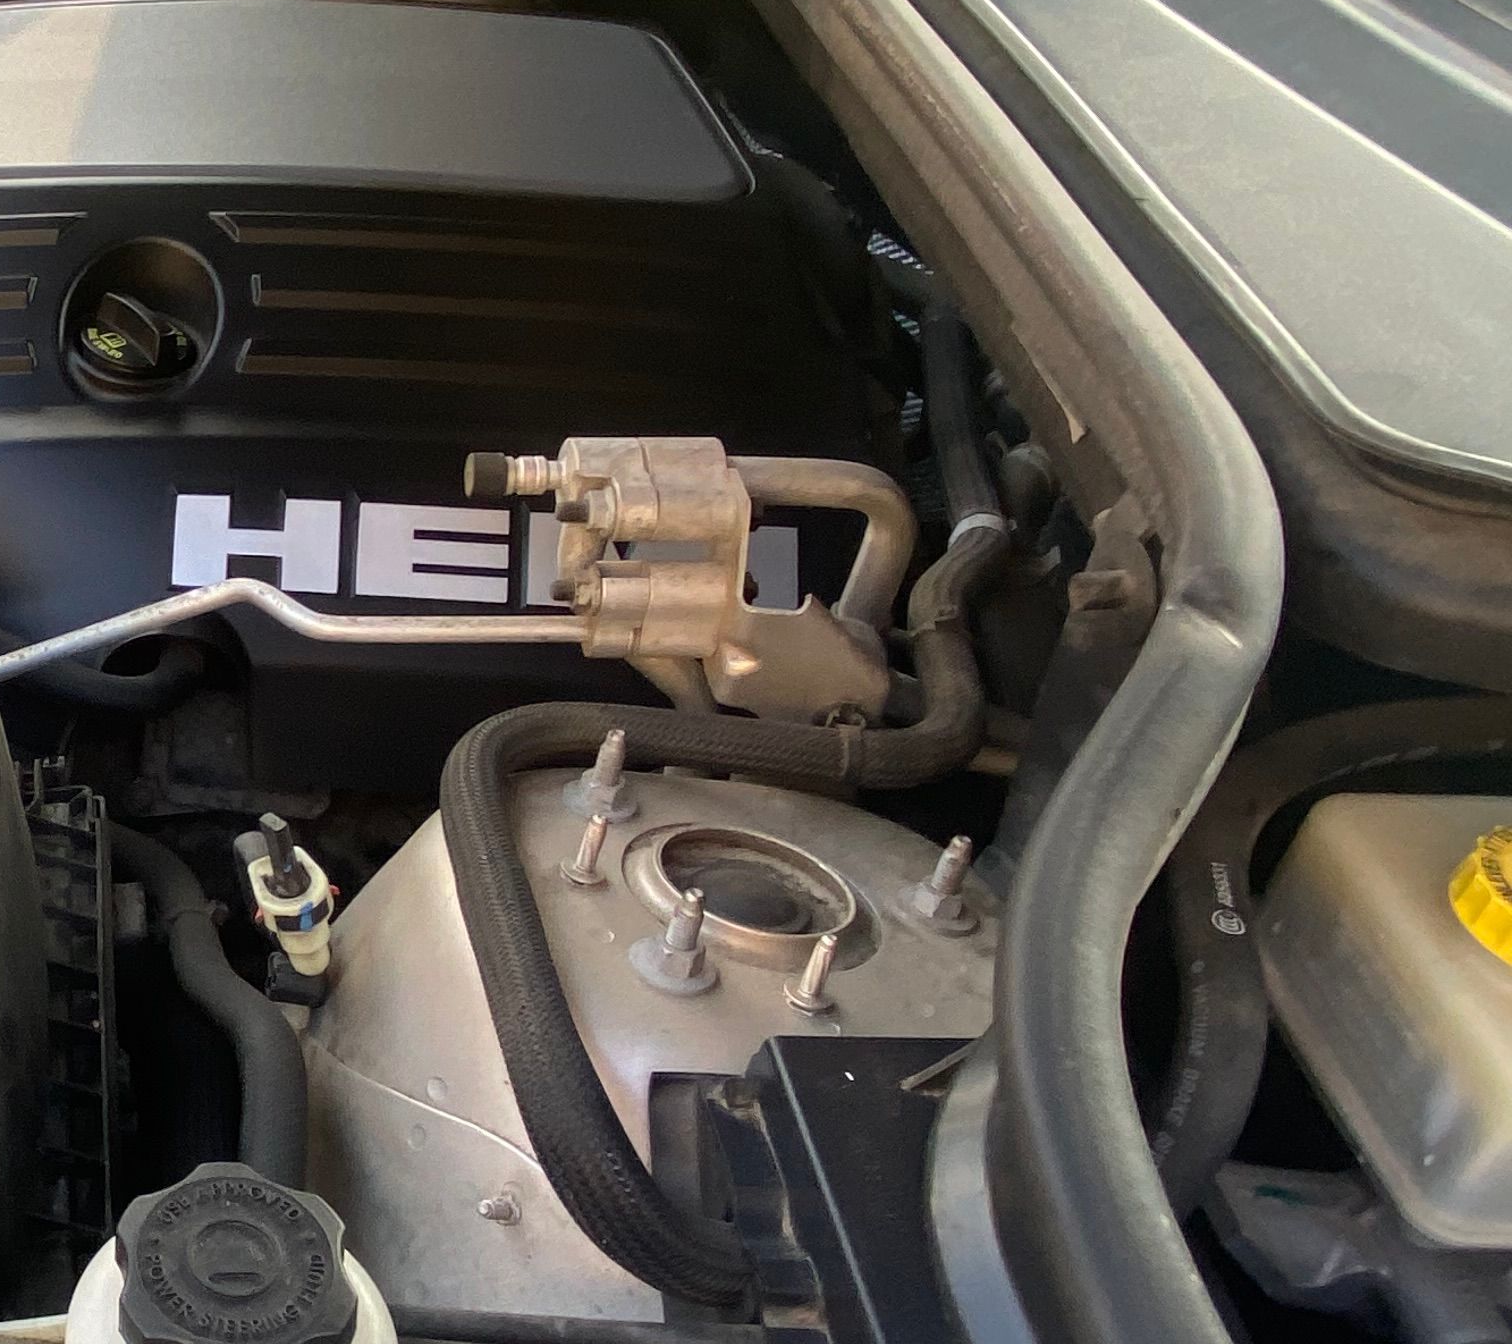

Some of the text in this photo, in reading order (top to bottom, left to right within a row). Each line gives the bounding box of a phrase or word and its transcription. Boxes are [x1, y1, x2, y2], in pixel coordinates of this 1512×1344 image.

[146, 1254, 325, 1335] POWER STEERING FLUID
